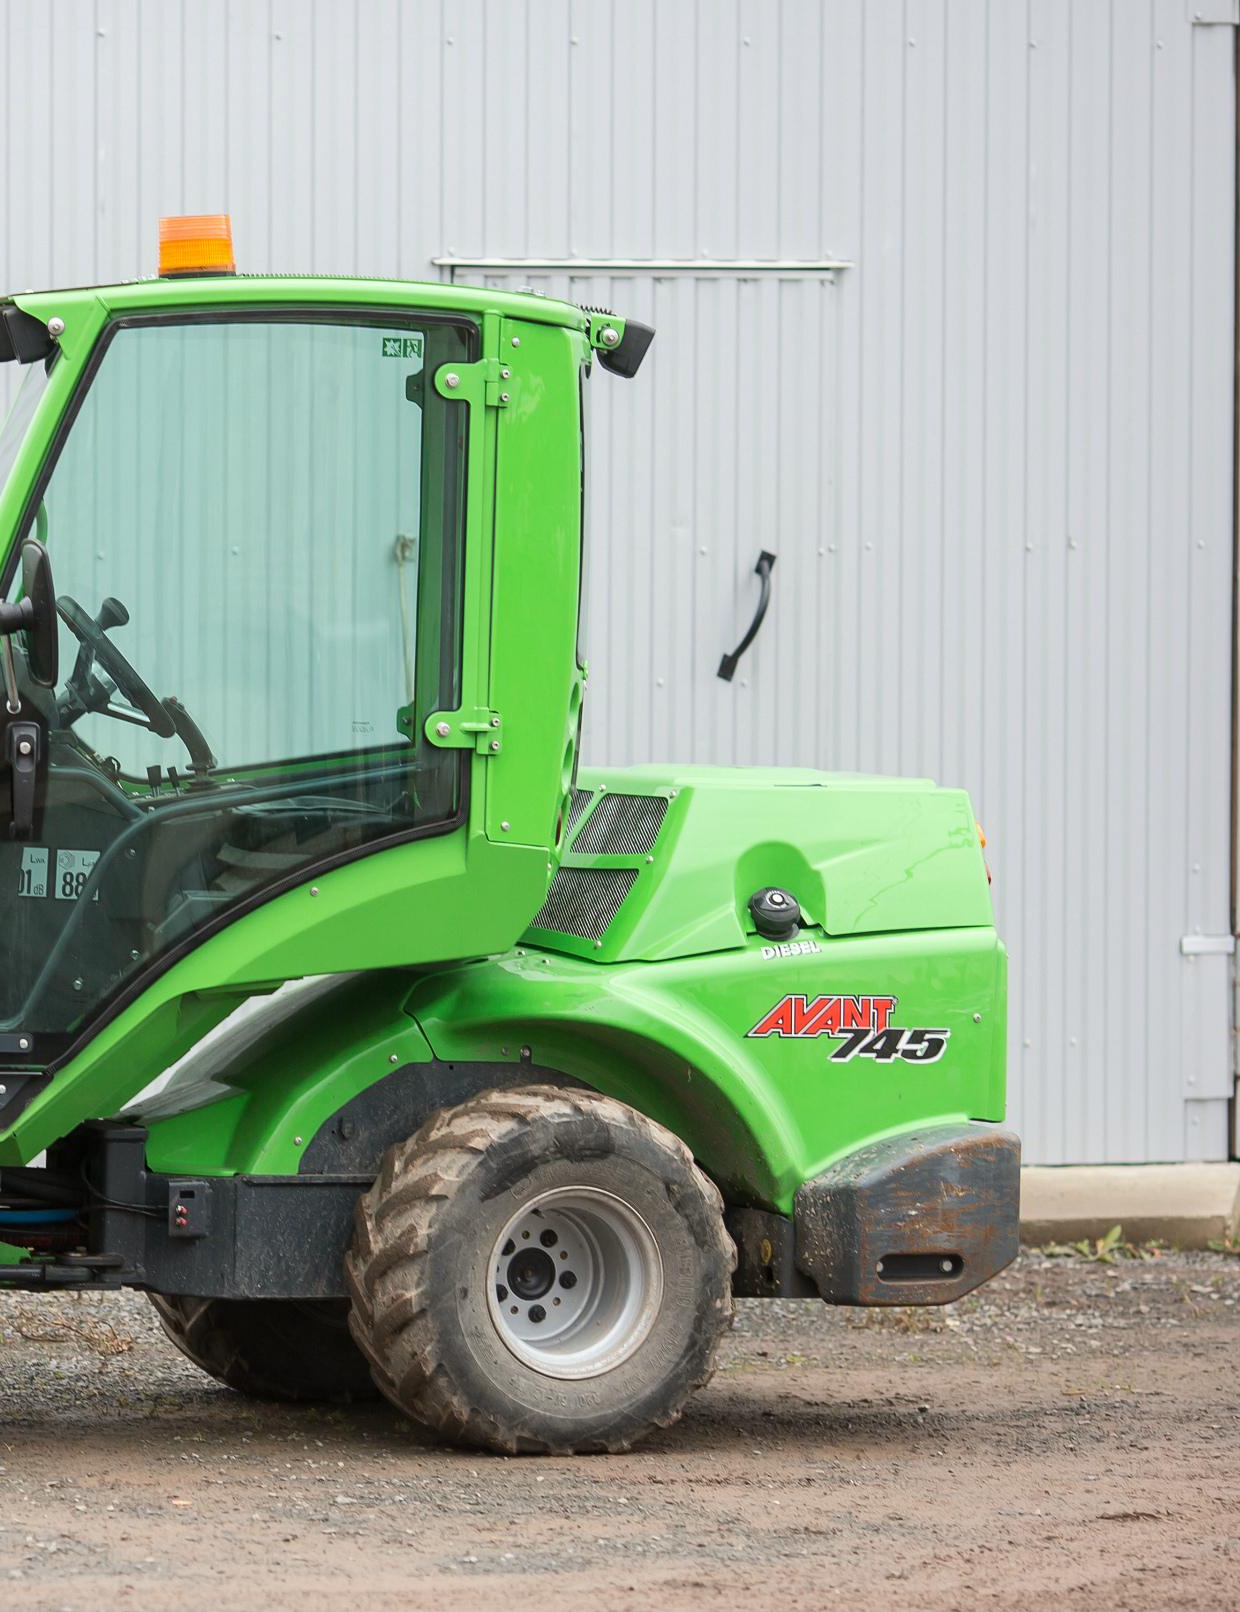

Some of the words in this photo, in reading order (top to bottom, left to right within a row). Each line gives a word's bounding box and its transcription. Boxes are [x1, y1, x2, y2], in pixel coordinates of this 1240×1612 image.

[760, 941, 822, 960] DIESEL
[745, 994, 898, 1038] AVANT
[828, 1028, 950, 1064] 745
